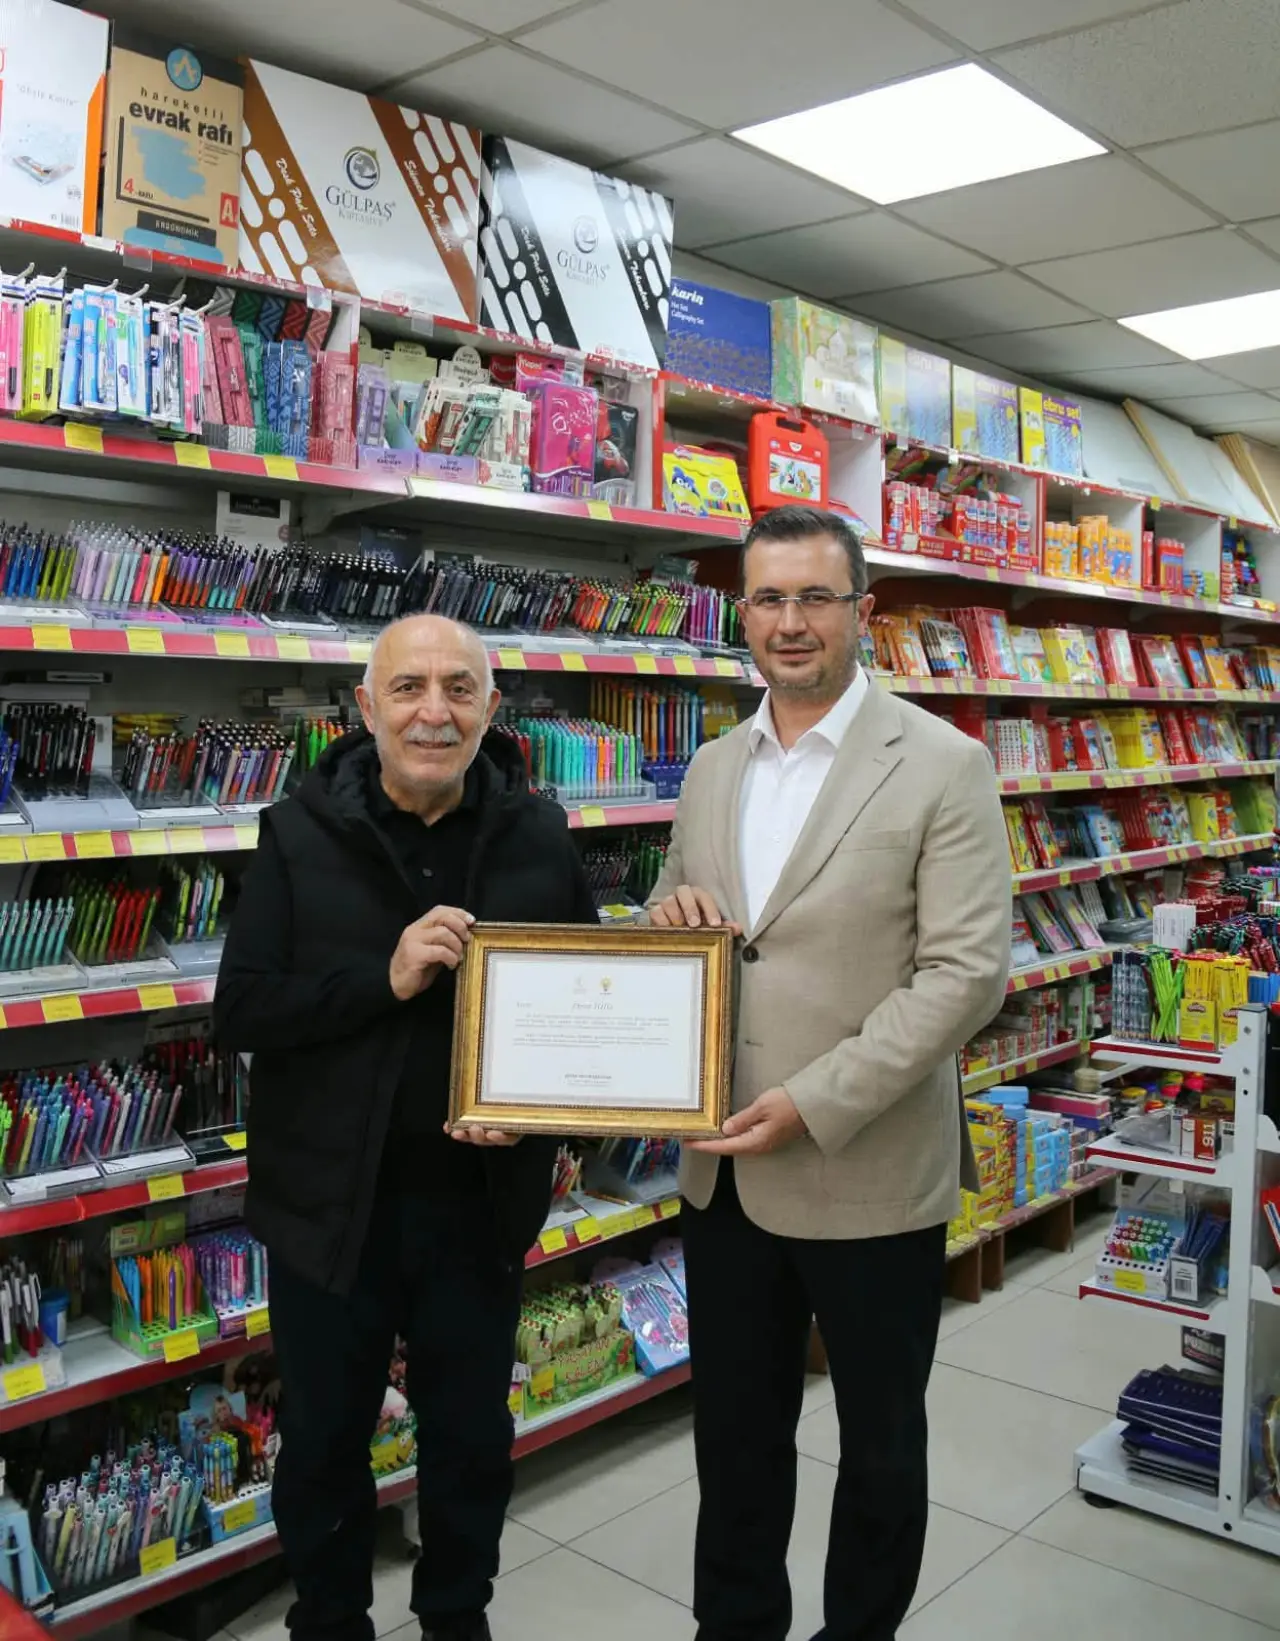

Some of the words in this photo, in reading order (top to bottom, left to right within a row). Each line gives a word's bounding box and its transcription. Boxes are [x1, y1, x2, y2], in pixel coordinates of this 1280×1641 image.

[140, 87, 224, 120] hareketli
[129, 102, 191, 133] evrak
[197, 121, 233, 146] rafı
[123, 178, 135, 195] 4
[326, 184, 393, 222] GÜLPAŞ
[671, 284, 704, 306] karin
